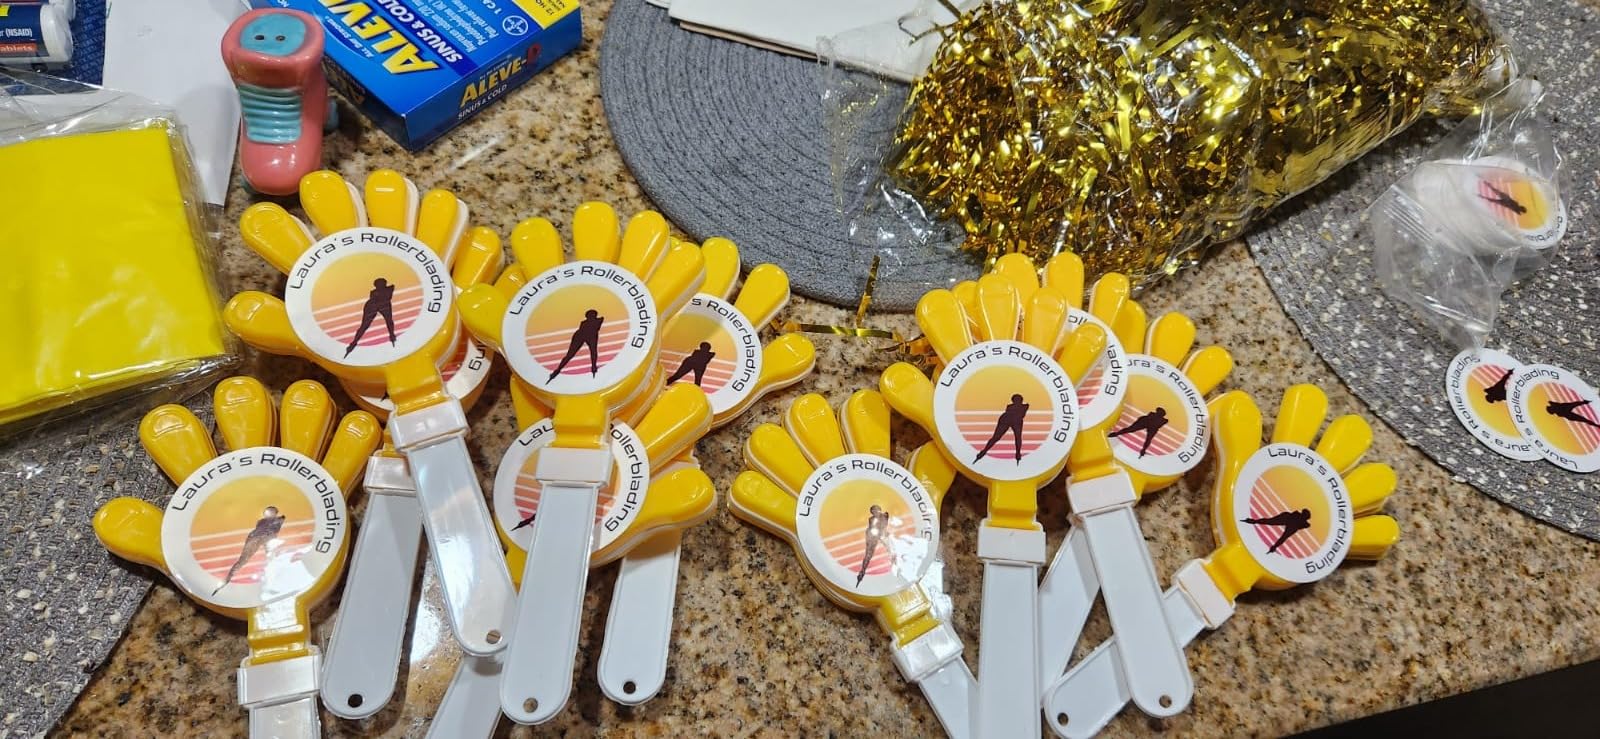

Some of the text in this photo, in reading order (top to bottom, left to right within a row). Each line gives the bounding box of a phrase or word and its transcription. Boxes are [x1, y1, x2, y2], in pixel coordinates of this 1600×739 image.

[318, 0, 439, 74] ALEV
[376, 0, 463, 63] SINUS & COL
[487, 84, 508, 100] COLD
[289, 232, 446, 313] Laura's Rollerblading
[508, 265, 652, 348] Laura's Rollerblading
[706, 300, 756, 392] Rollerblading
[940, 345, 1074, 443] Laura's Rollerblading
[1168, 372, 1207, 464] Rollerblading
[1511, 368, 1560, 424] Rollerblading
[172, 453, 340, 554] Laura's Rollerblading
[799, 463, 847, 517] Laura's
[1267, 447, 1348, 574] Laura's Rollerblading
